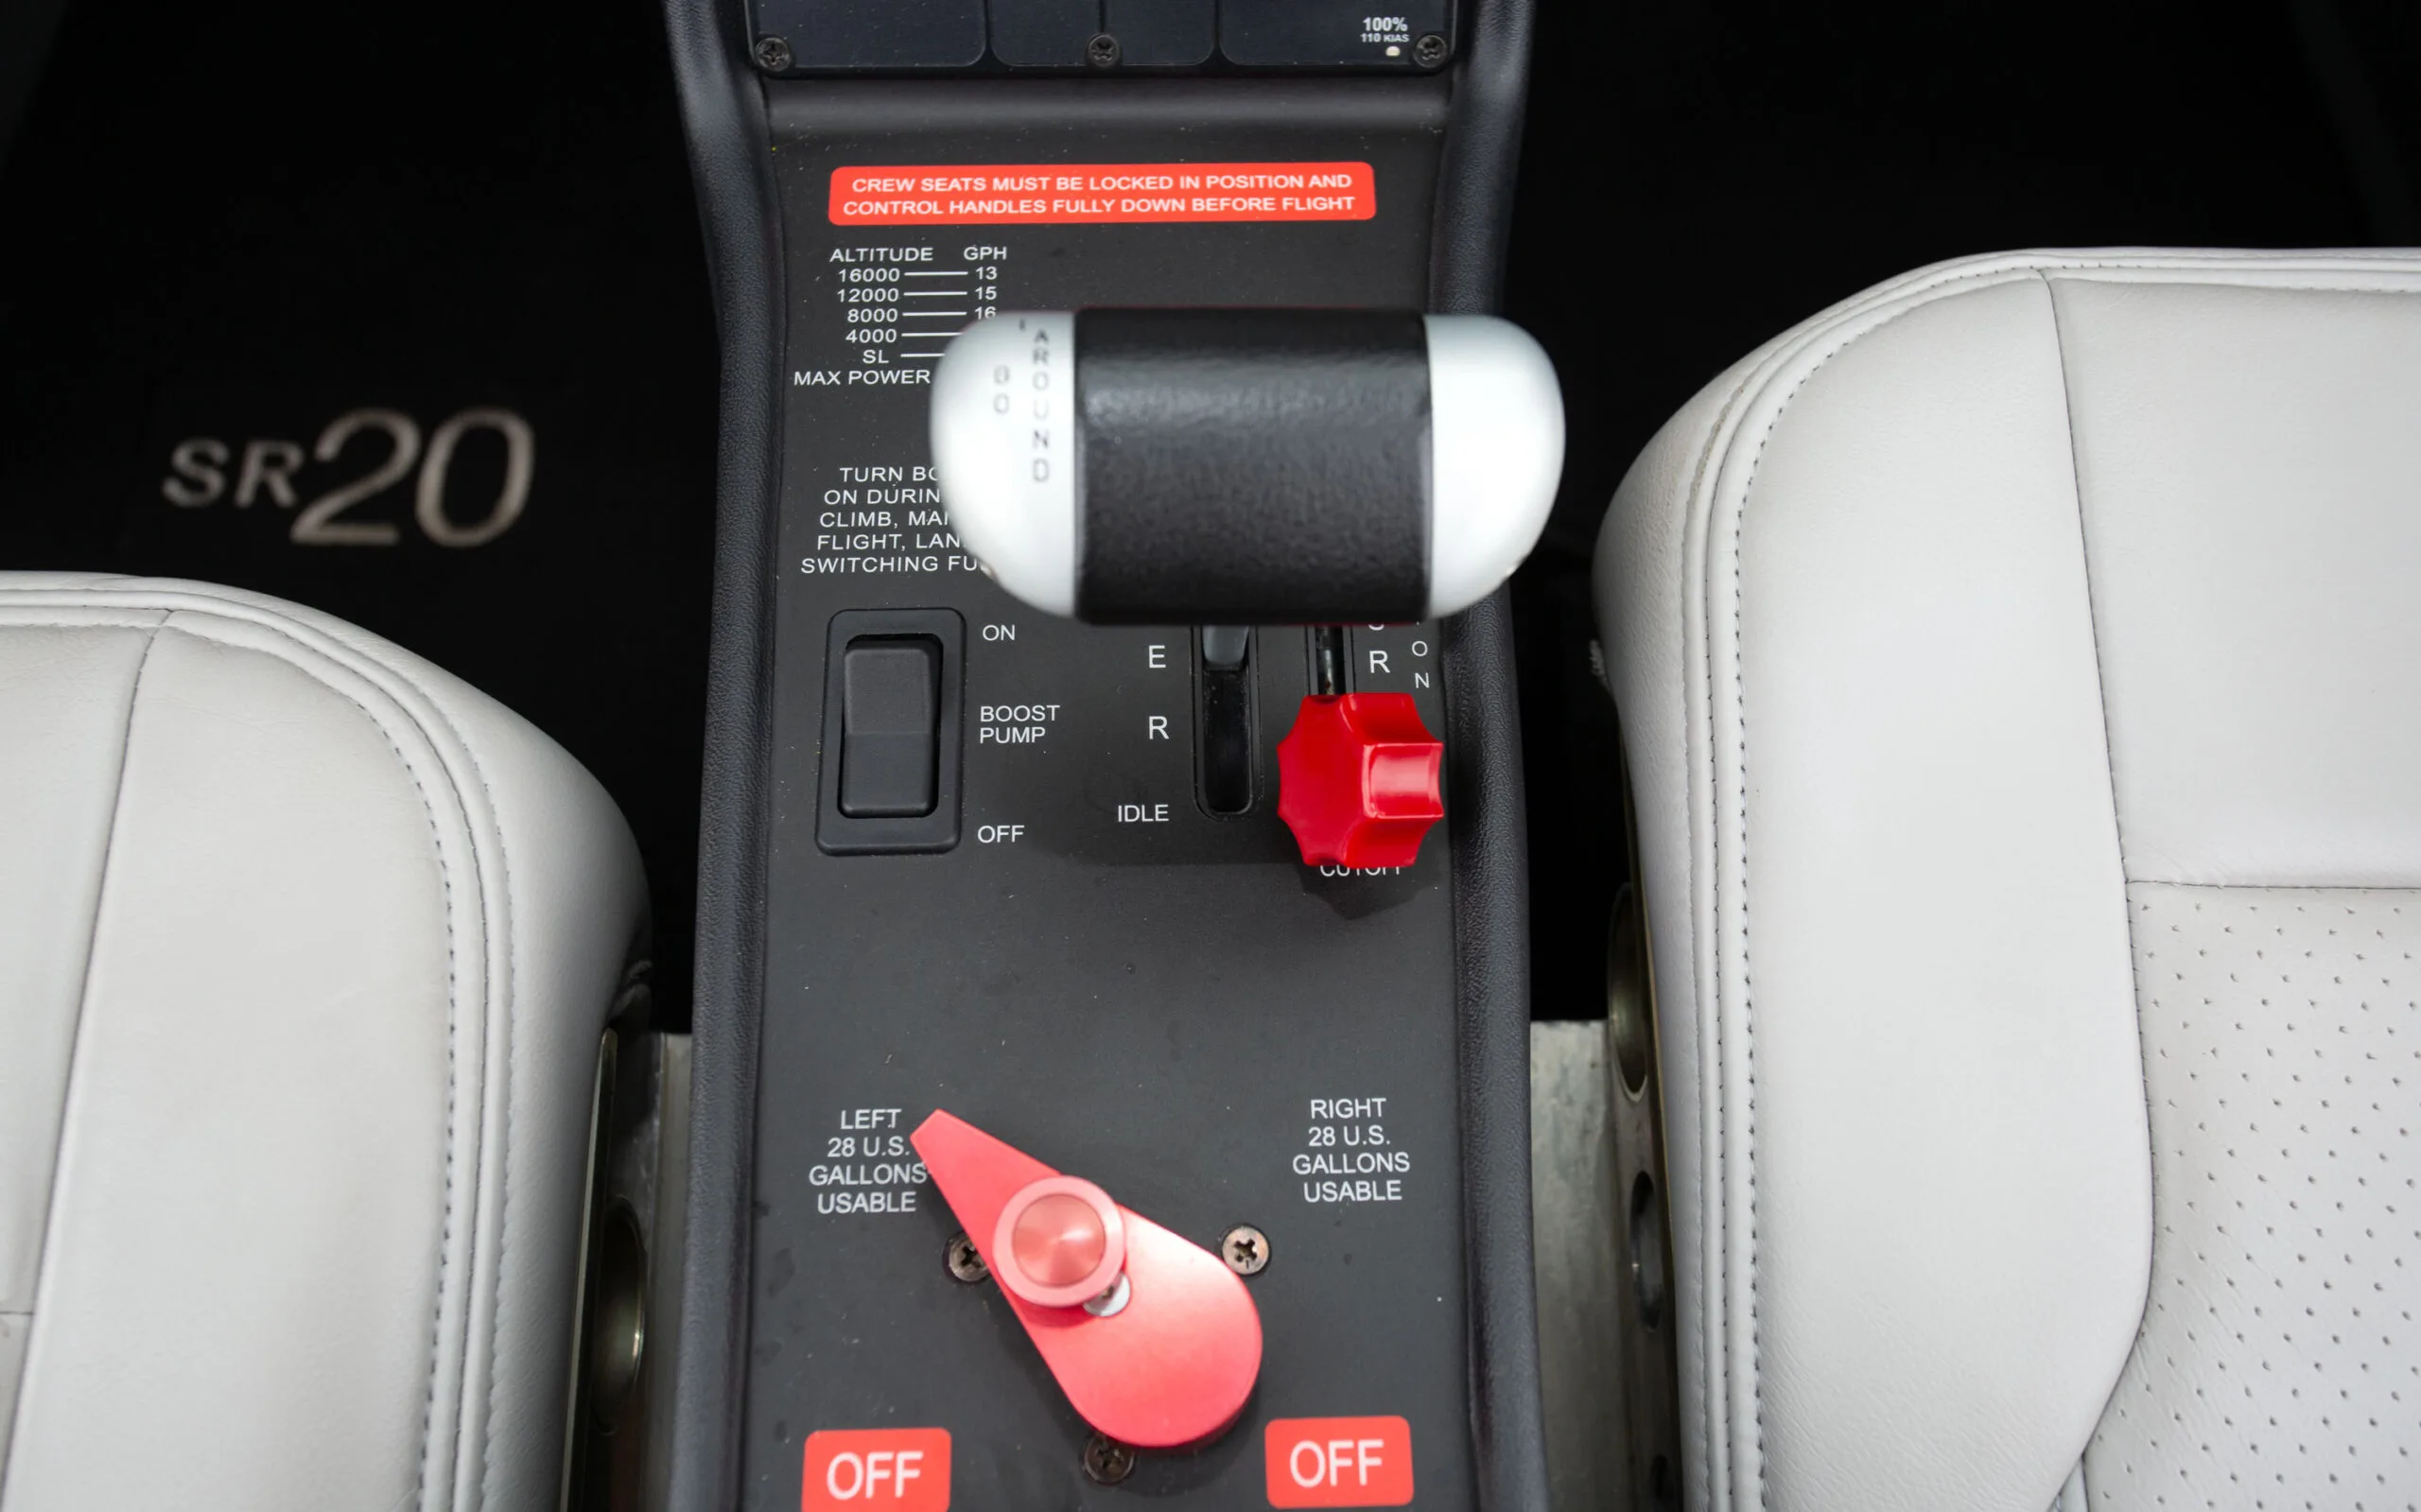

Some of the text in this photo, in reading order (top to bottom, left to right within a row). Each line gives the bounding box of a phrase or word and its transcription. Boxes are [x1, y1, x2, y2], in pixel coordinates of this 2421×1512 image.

[1362, 16, 1408, 32] 100%
[1360, 32, 1410, 43] 110 KIAS
[851, 173, 1352, 193] CREW SEATS MUST BE LOCKED IN POSITION AND
[843, 196, 1355, 216] CONTROL HANDLES FULLY DOWN BEFORE FLIGHT
[829, 246, 1007, 263] ALTITUDE GPH
[838, 266, 998, 283] 16000 13
[837, 286, 997, 303] 12000 15
[846, 305, 997, 323] 8000 16
[845, 328, 897, 344] 4000
[862, 349, 889, 364] SL
[793, 369, 931, 386] MAX POWER
[162, 407, 535, 547] SR20
[839, 465, 939, 482] TURN BO
[824, 487, 941, 505] ON DURIN
[819, 511, 898, 529] CLIMB,
[817, 532, 966, 551] FLIGHT, LAN
[800, 555, 979, 574] SWITCHING FU
[982, 624, 1016, 641] ON
[980, 704, 1061, 722] BOOST
[980, 726, 1046, 744] PUMP
[1117, 804, 1170, 823] IDLE
[977, 825, 1025, 843] OFF
[1310, 1097, 1387, 1120] RIGHT
[840, 1108, 902, 1130] LEFT
[1308, 1124, 1390, 1147] 28 U.S.
[827, 1135, 910, 1157] 28 U.S.
[1292, 1151, 1411, 1175] GALLONS
[809, 1162, 928, 1187] GALLONS
[1303, 1179, 1402, 1203] USABLE
[817, 1190, 916, 1214] USABLE
[1289, 1438, 1385, 1488] OFF
[827, 1450, 924, 1502] OFF
